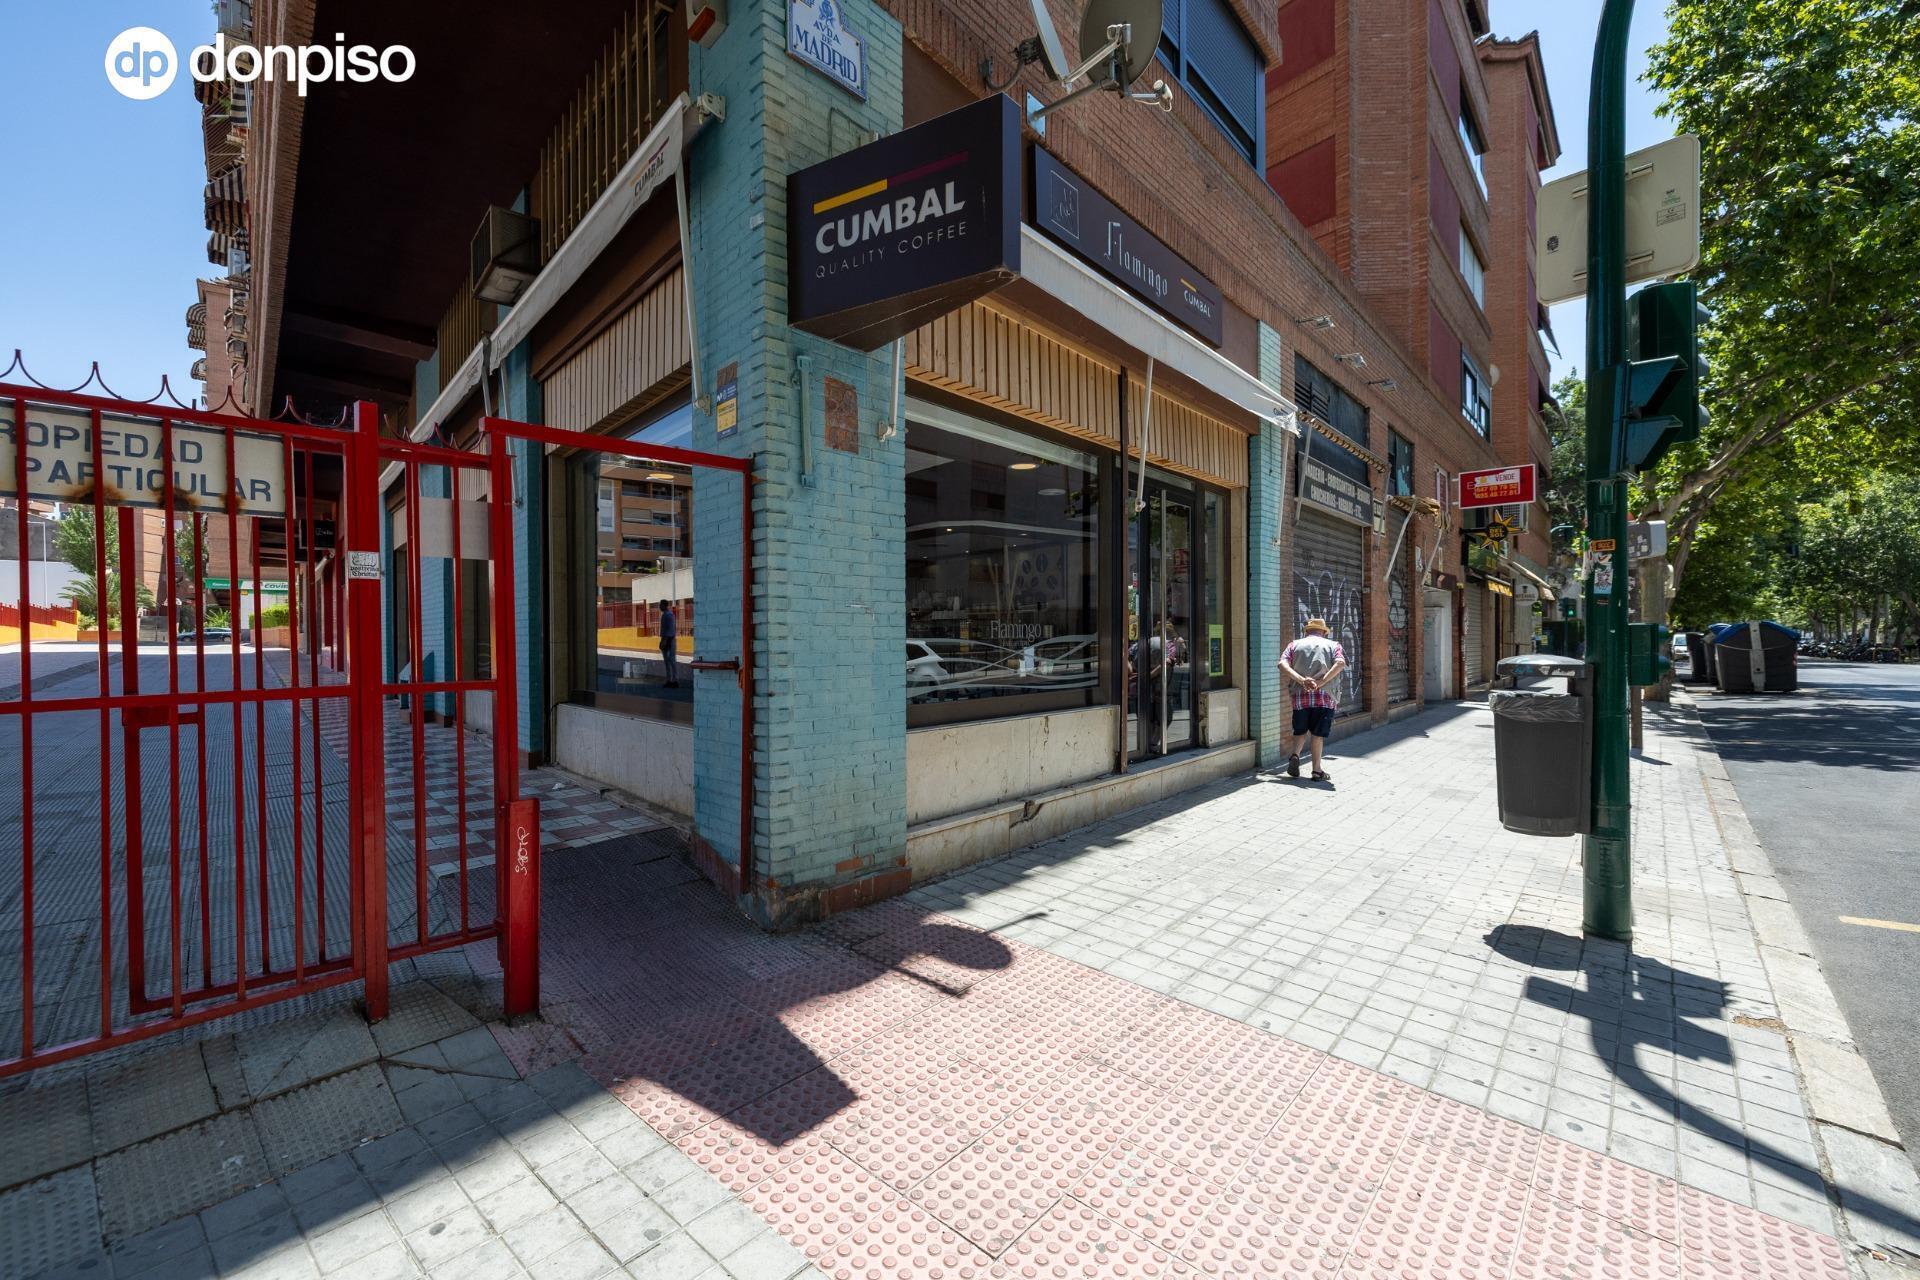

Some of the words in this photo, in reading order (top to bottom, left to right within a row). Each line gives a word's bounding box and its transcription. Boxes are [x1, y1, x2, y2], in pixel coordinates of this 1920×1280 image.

[795, 23, 858, 83] MADRID
[815, 180, 966, 254] CUMBAL
[815, 247, 886, 279] QUALITY
[897, 221, 967, 254] COFFEE
[1103, 221, 1168, 297] Flamingo
[1183, 289, 1212, 318] CUMBAL
[0, 417, 203, 464] ROPIEDAD
[1495, 473, 1516, 482] VENDE
[990, 618, 1042, 643] Flamingo
